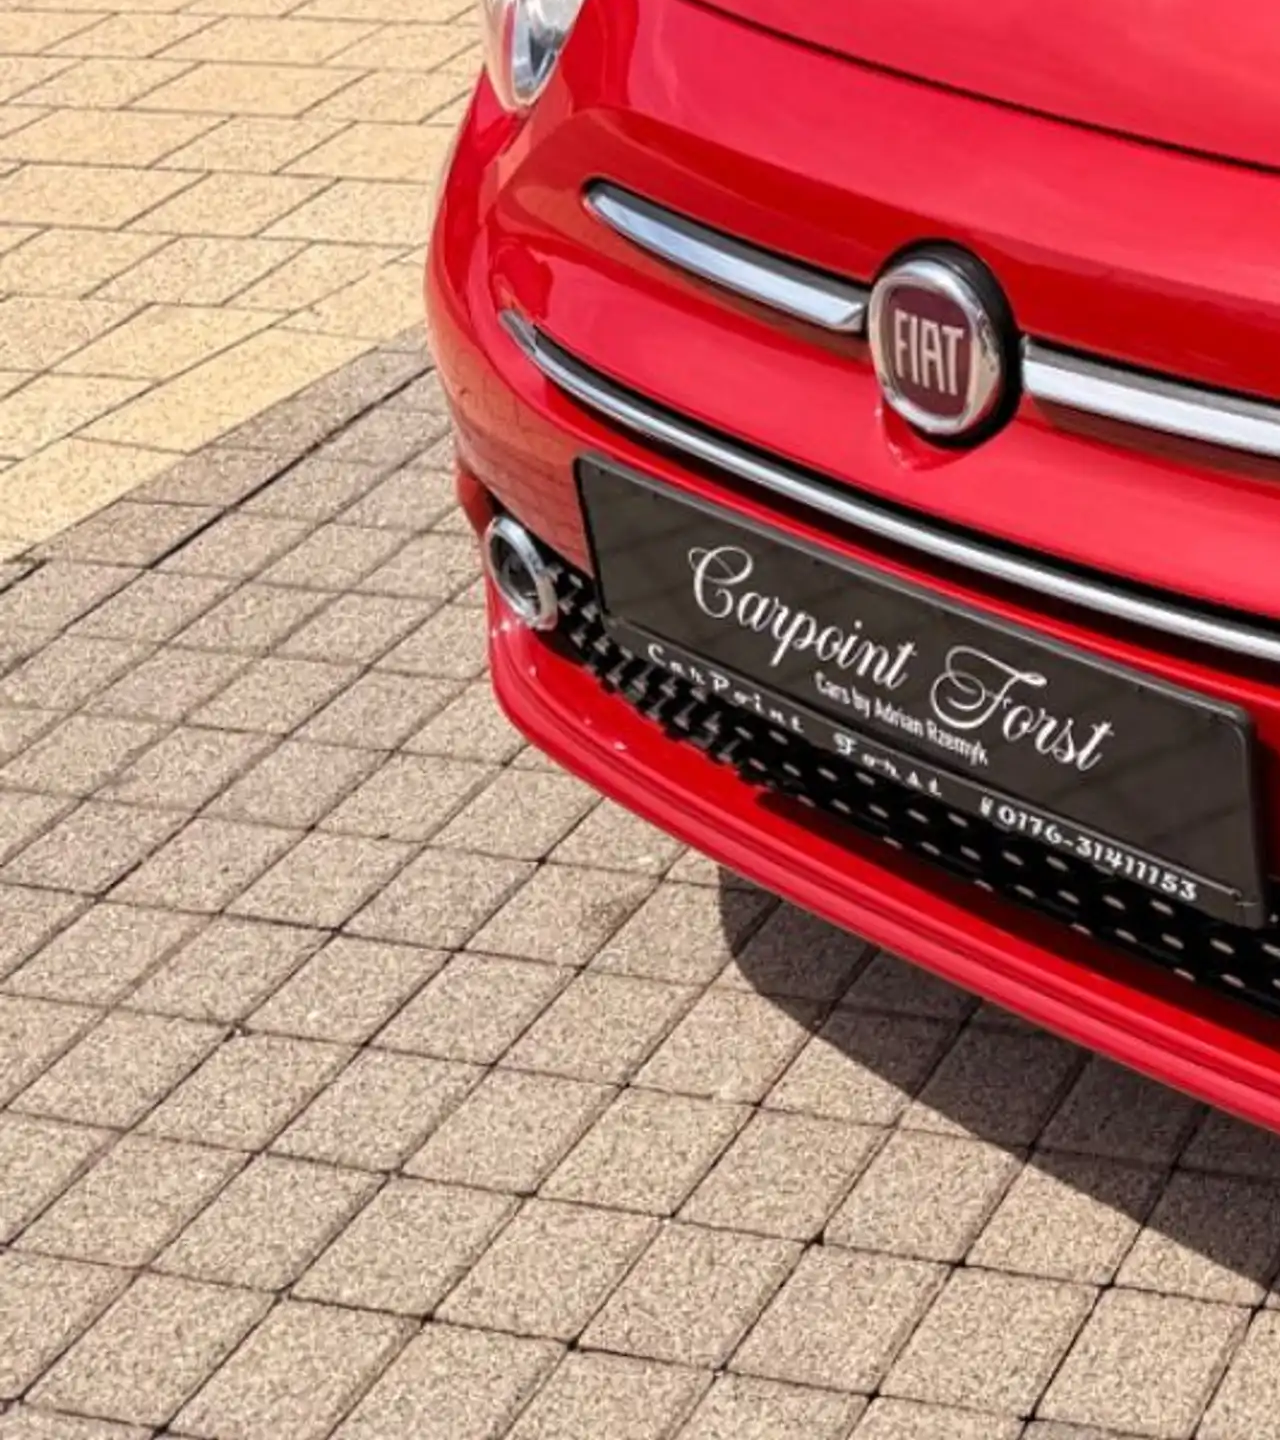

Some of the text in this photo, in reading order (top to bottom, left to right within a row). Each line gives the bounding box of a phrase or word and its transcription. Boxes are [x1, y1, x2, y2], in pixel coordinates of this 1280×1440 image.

[894, 308, 965, 397] FIAT
[688, 545, 1115, 771] Carpoint Forst
[814, 671, 852, 705] Cars
[851, 686, 871, 720] by
